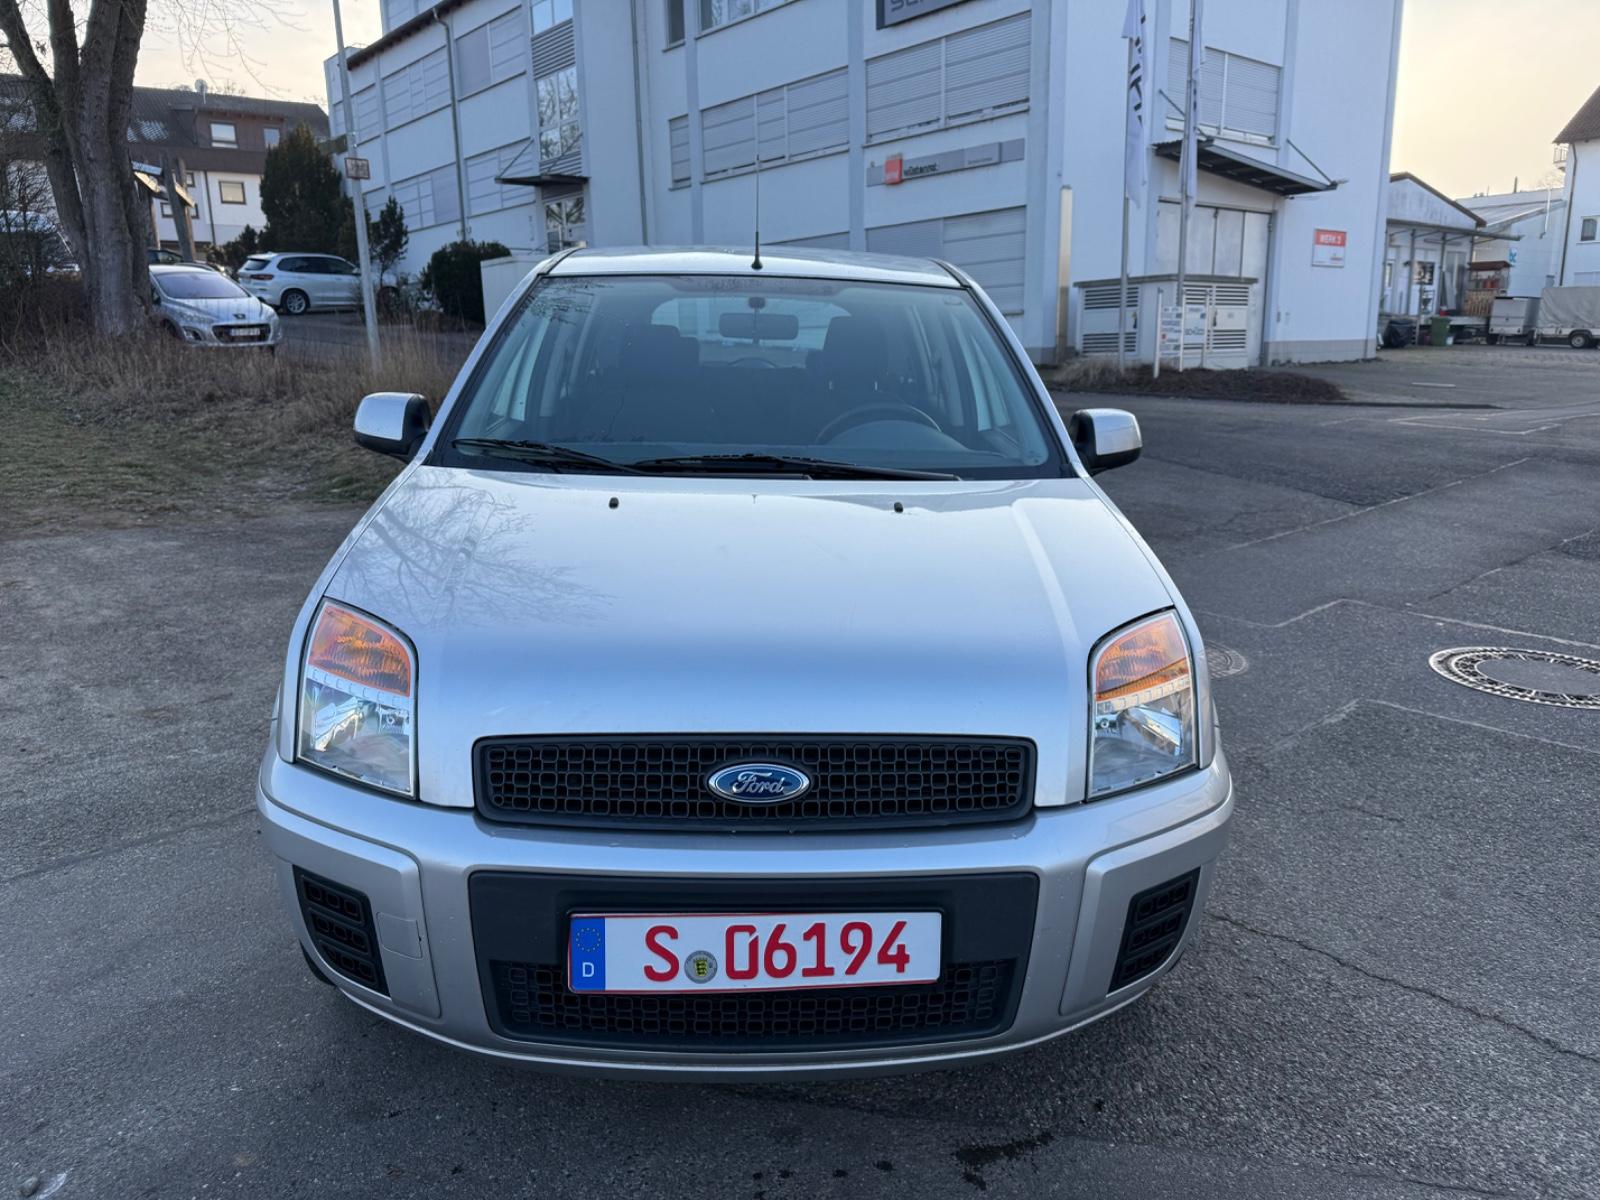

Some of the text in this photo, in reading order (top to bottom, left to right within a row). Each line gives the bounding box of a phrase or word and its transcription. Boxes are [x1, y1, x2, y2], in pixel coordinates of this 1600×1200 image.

[732, 771, 786, 794] Ford
[643, 921, 910, 982] S 06194
[581, 962, 595, 978] D
